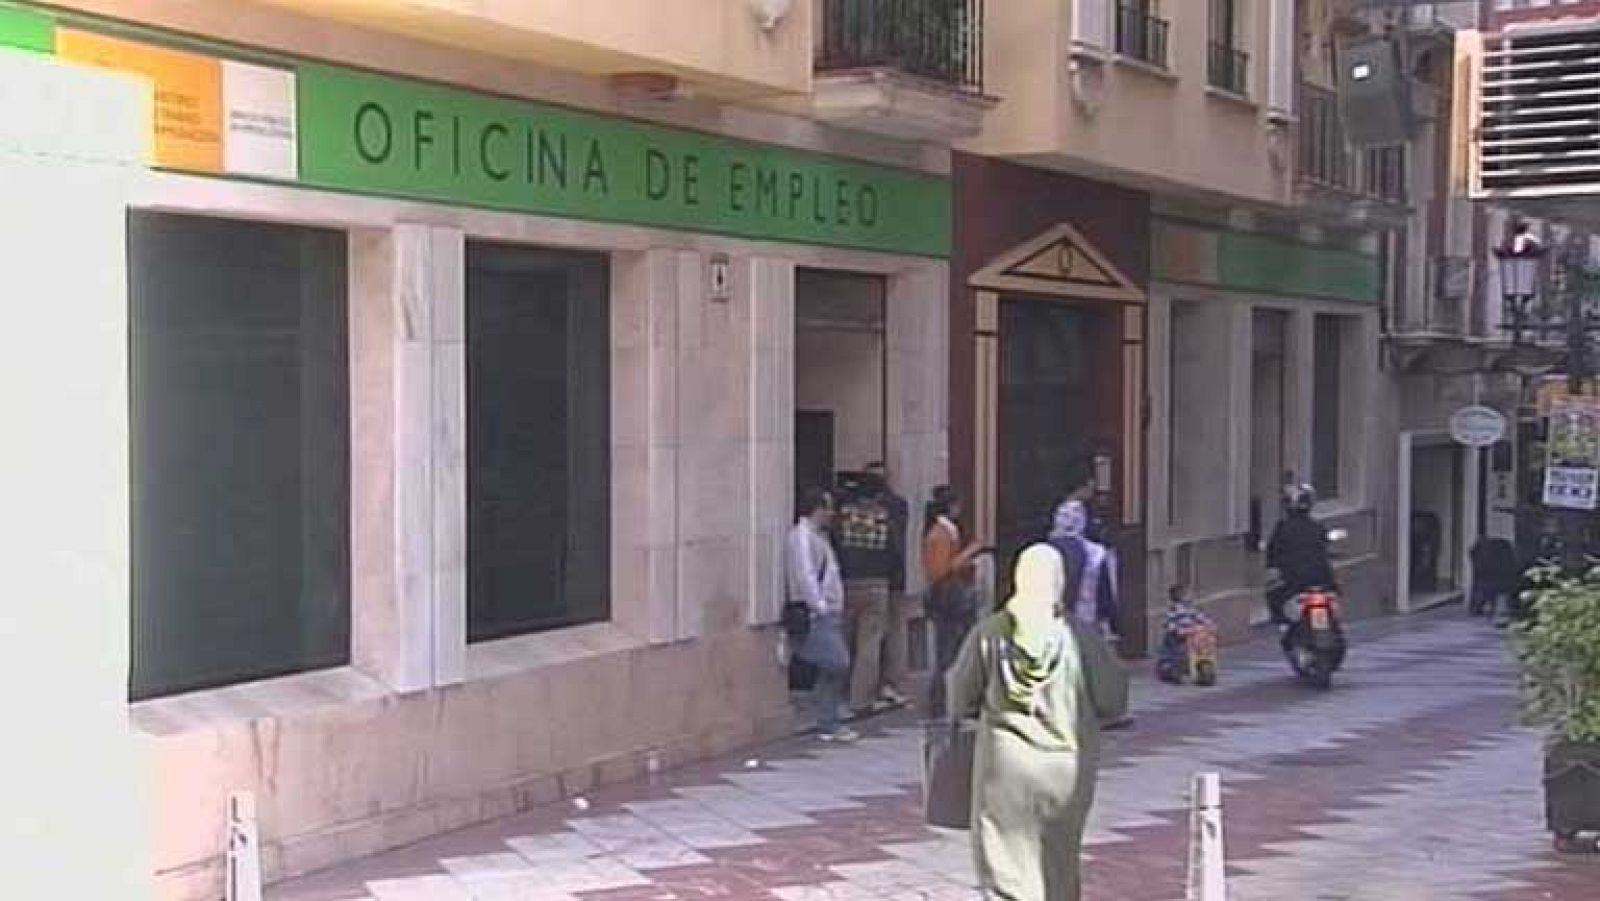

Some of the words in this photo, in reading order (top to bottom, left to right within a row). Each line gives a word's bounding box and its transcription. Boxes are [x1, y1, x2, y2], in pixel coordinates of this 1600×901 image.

[353, 102, 609, 192] OFICINA
[646, 149, 700, 205] DE
[731, 163, 879, 227] EMPLEO
